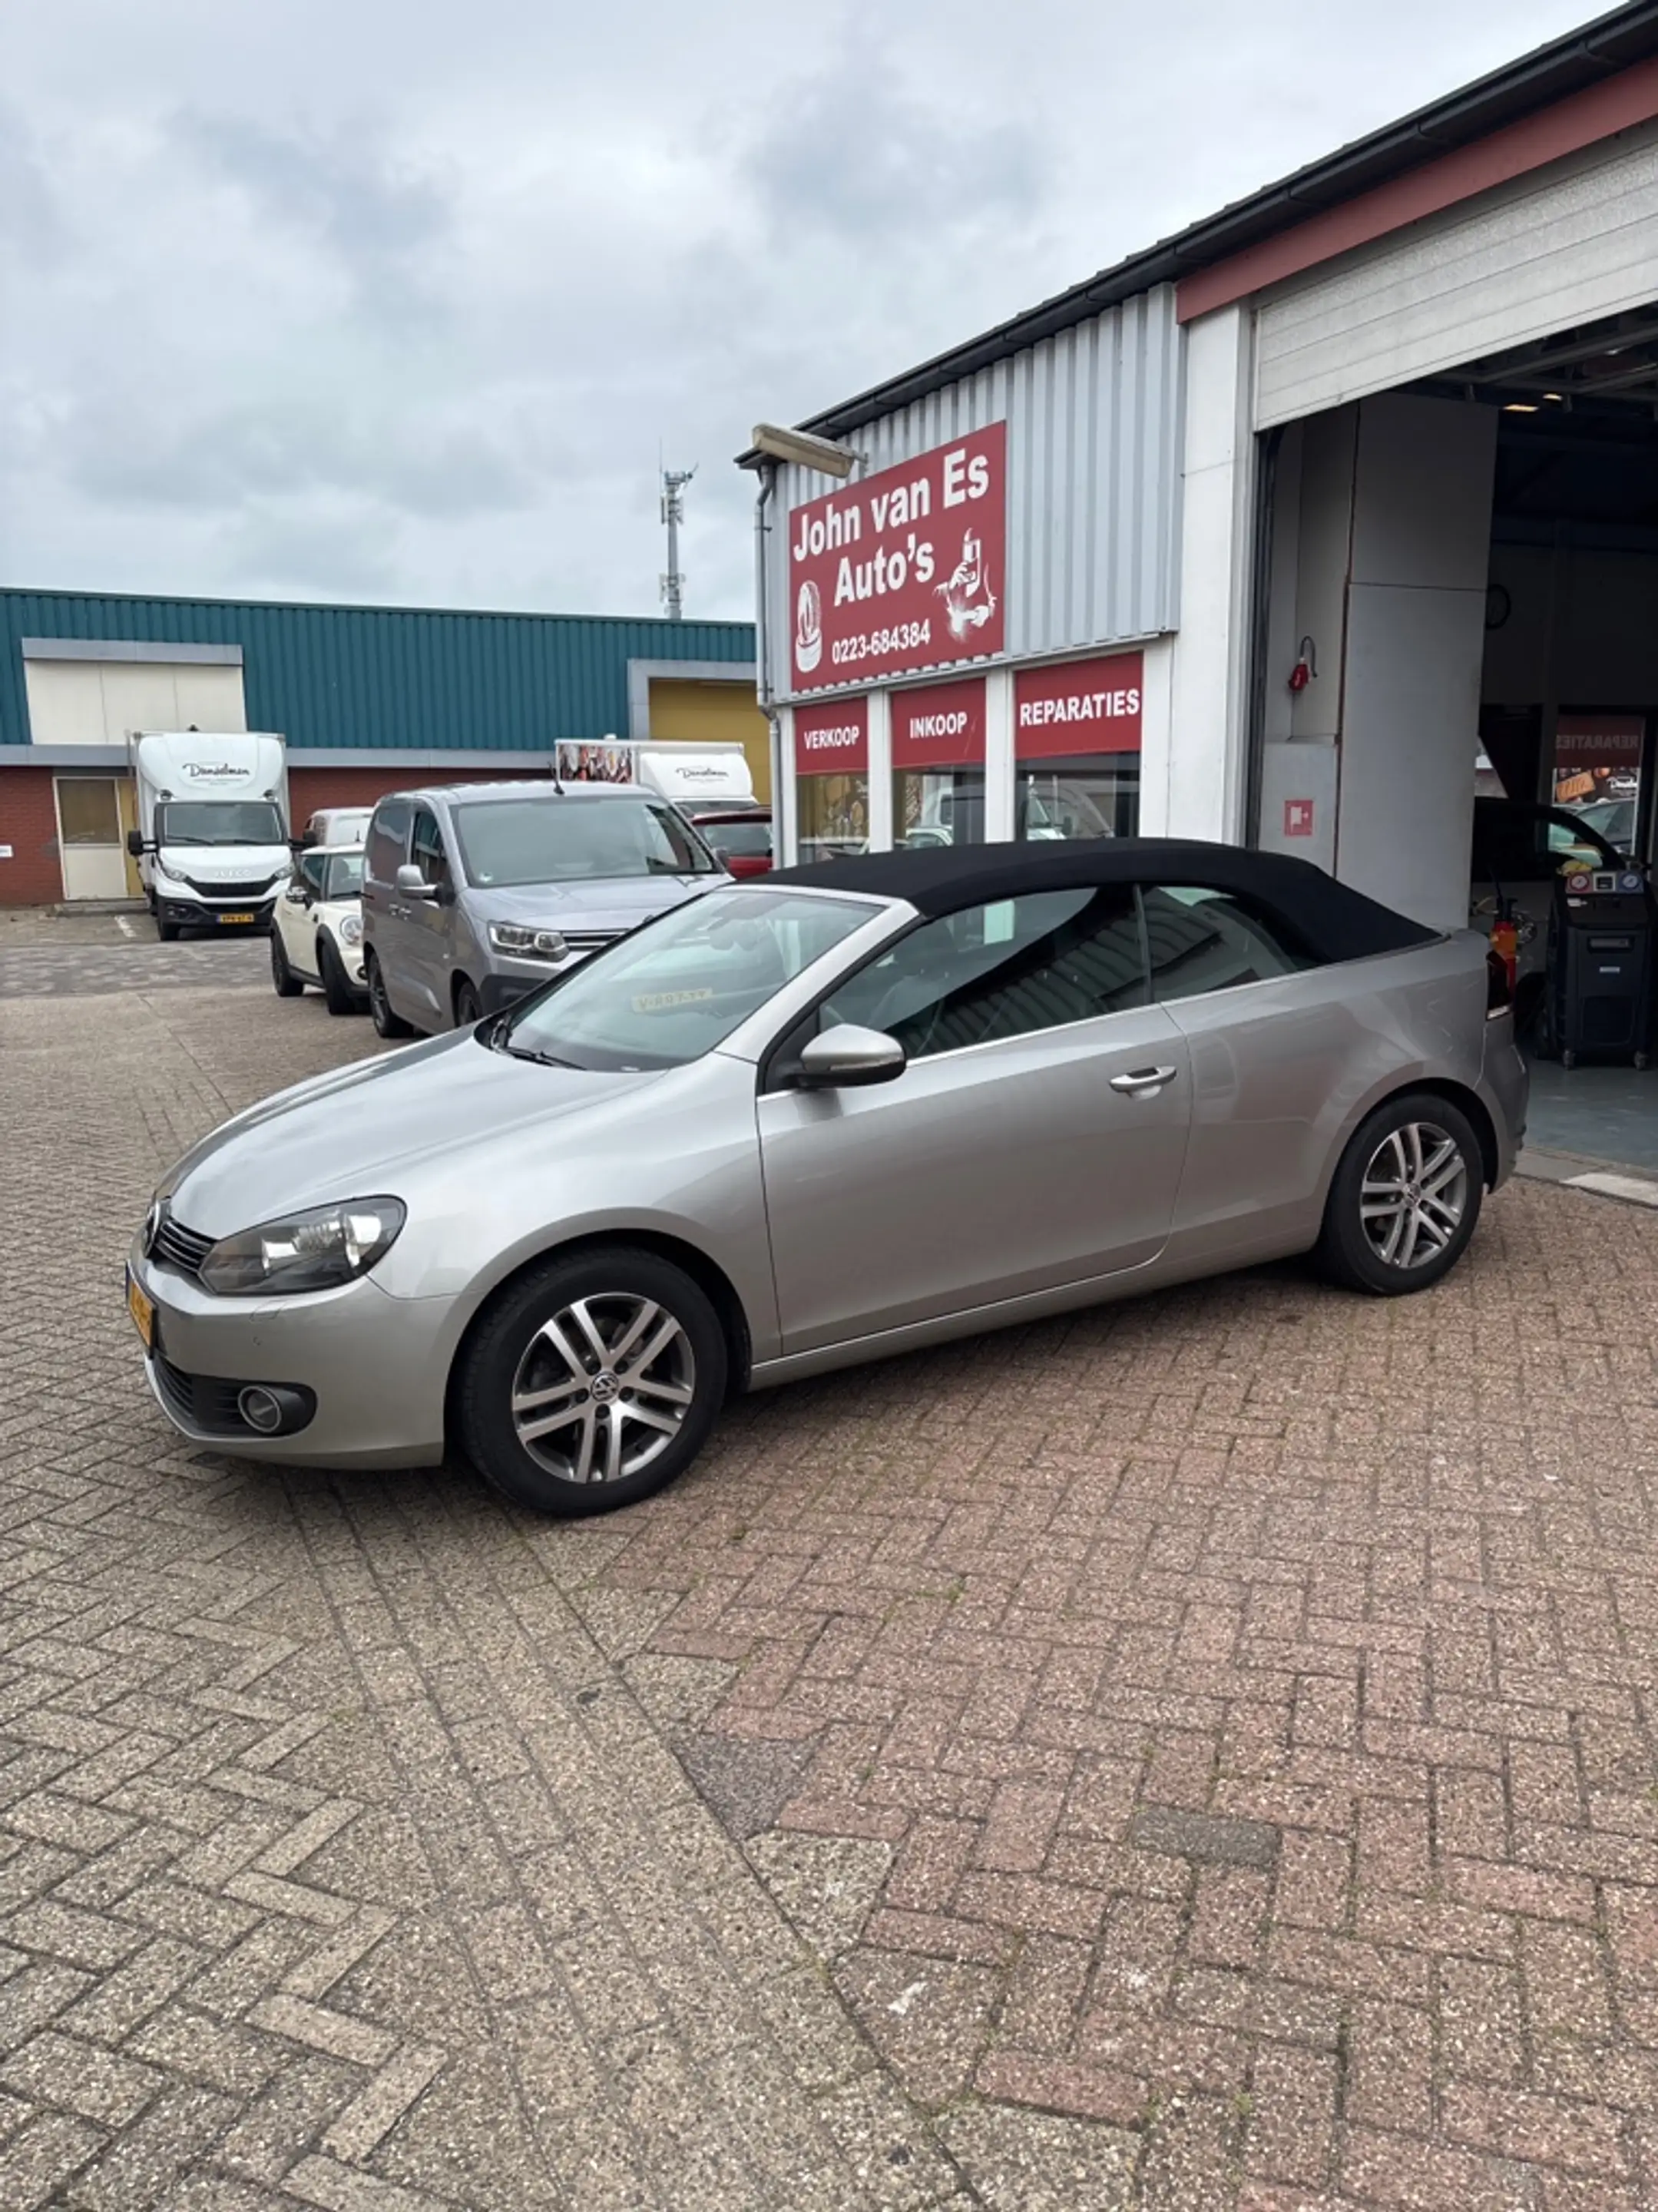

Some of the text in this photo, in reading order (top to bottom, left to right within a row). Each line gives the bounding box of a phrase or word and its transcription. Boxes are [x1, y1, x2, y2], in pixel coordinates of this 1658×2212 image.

[793, 449, 989, 561] John van Es
[833, 533, 935, 607] Auto's
[832, 618, 932, 664] 0223-684384
[909, 711, 968, 739] INKOOP
[1020, 688, 1140, 727] REPARATIES
[803, 725, 859, 750] VERKOOP
